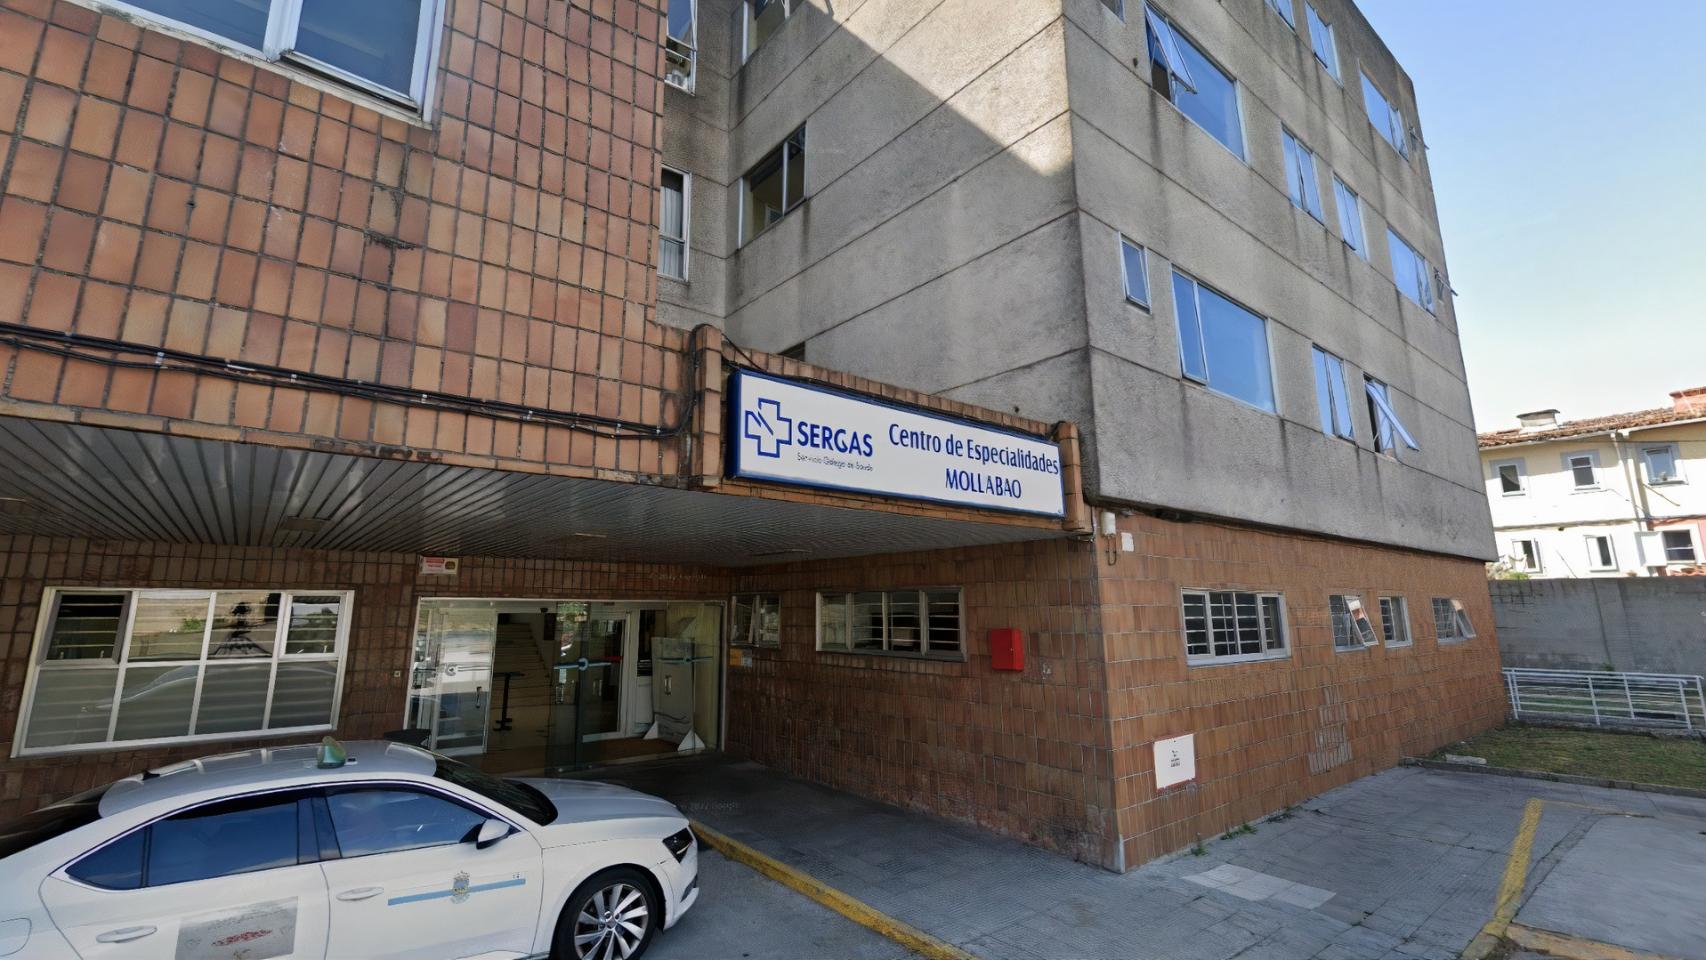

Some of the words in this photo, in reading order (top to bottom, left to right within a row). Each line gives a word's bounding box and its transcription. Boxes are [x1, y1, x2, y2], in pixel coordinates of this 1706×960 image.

[797, 421, 873, 457] SERGAS
[889, 423, 942, 453] Centro
[945, 434, 963, 457] de
[967, 439, 1059, 474] Especialidades
[945, 468, 1022, 498] MOLLABAO
